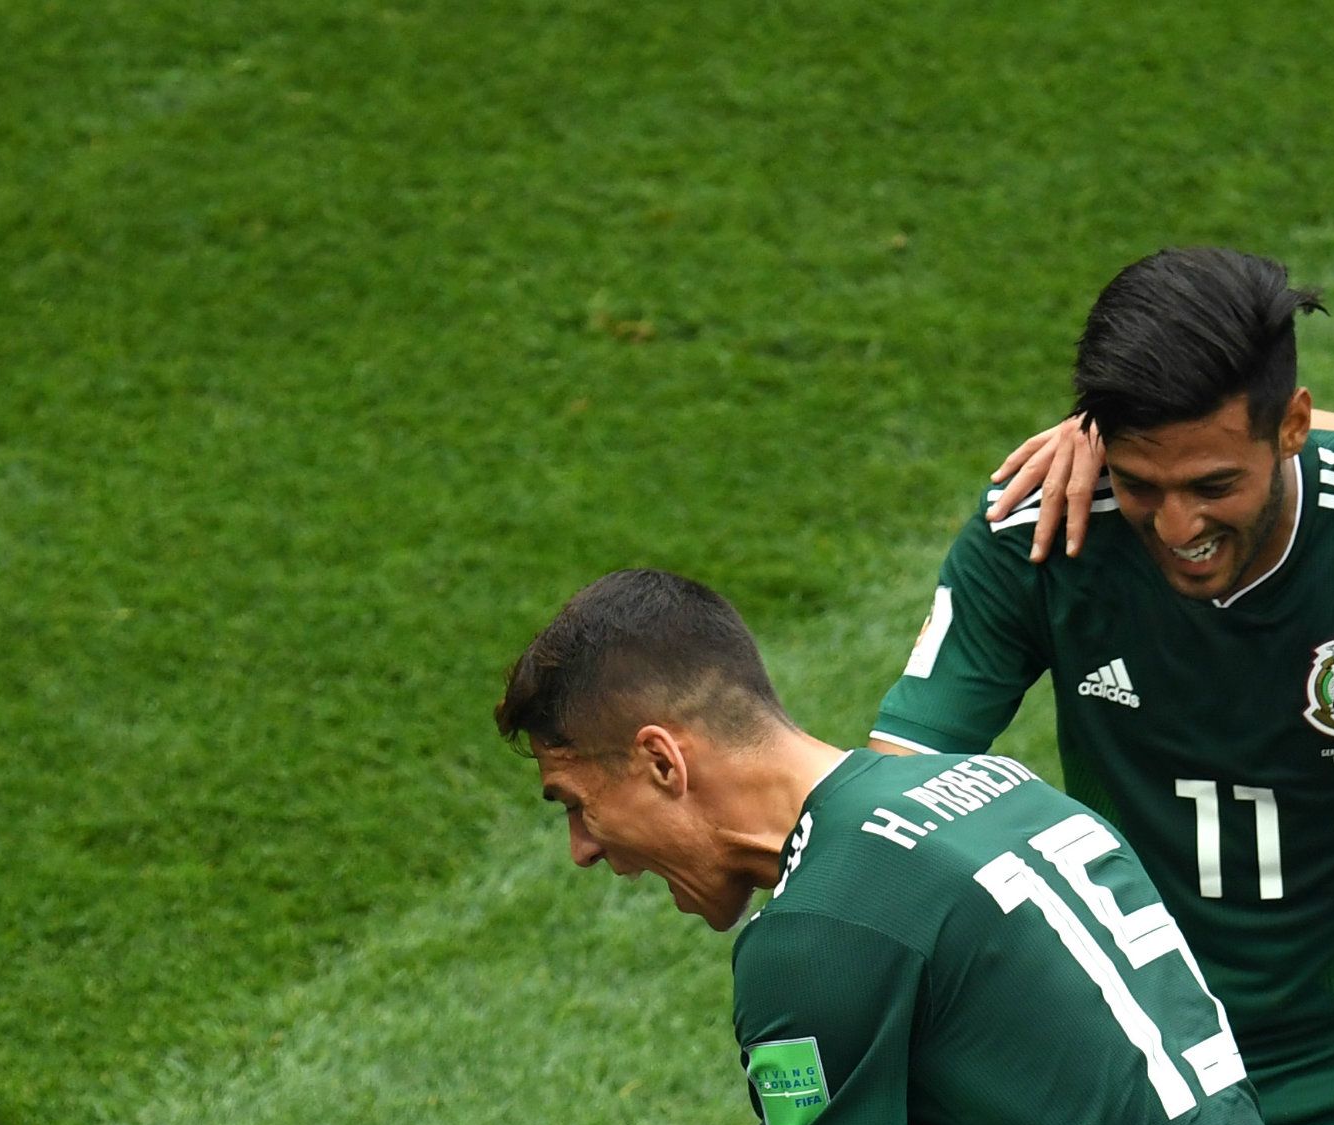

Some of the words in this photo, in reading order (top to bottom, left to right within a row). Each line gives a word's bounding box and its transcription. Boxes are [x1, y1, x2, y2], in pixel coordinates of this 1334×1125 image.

[1077, 681, 1141, 709] adidas
[860, 807, 938, 850] H.
[902, 754, 1043, 822] MOREN
[1174, 778, 1284, 900] 11
[972, 813, 1247, 1121] 15
[795, 1095, 823, 1109] FIFA
